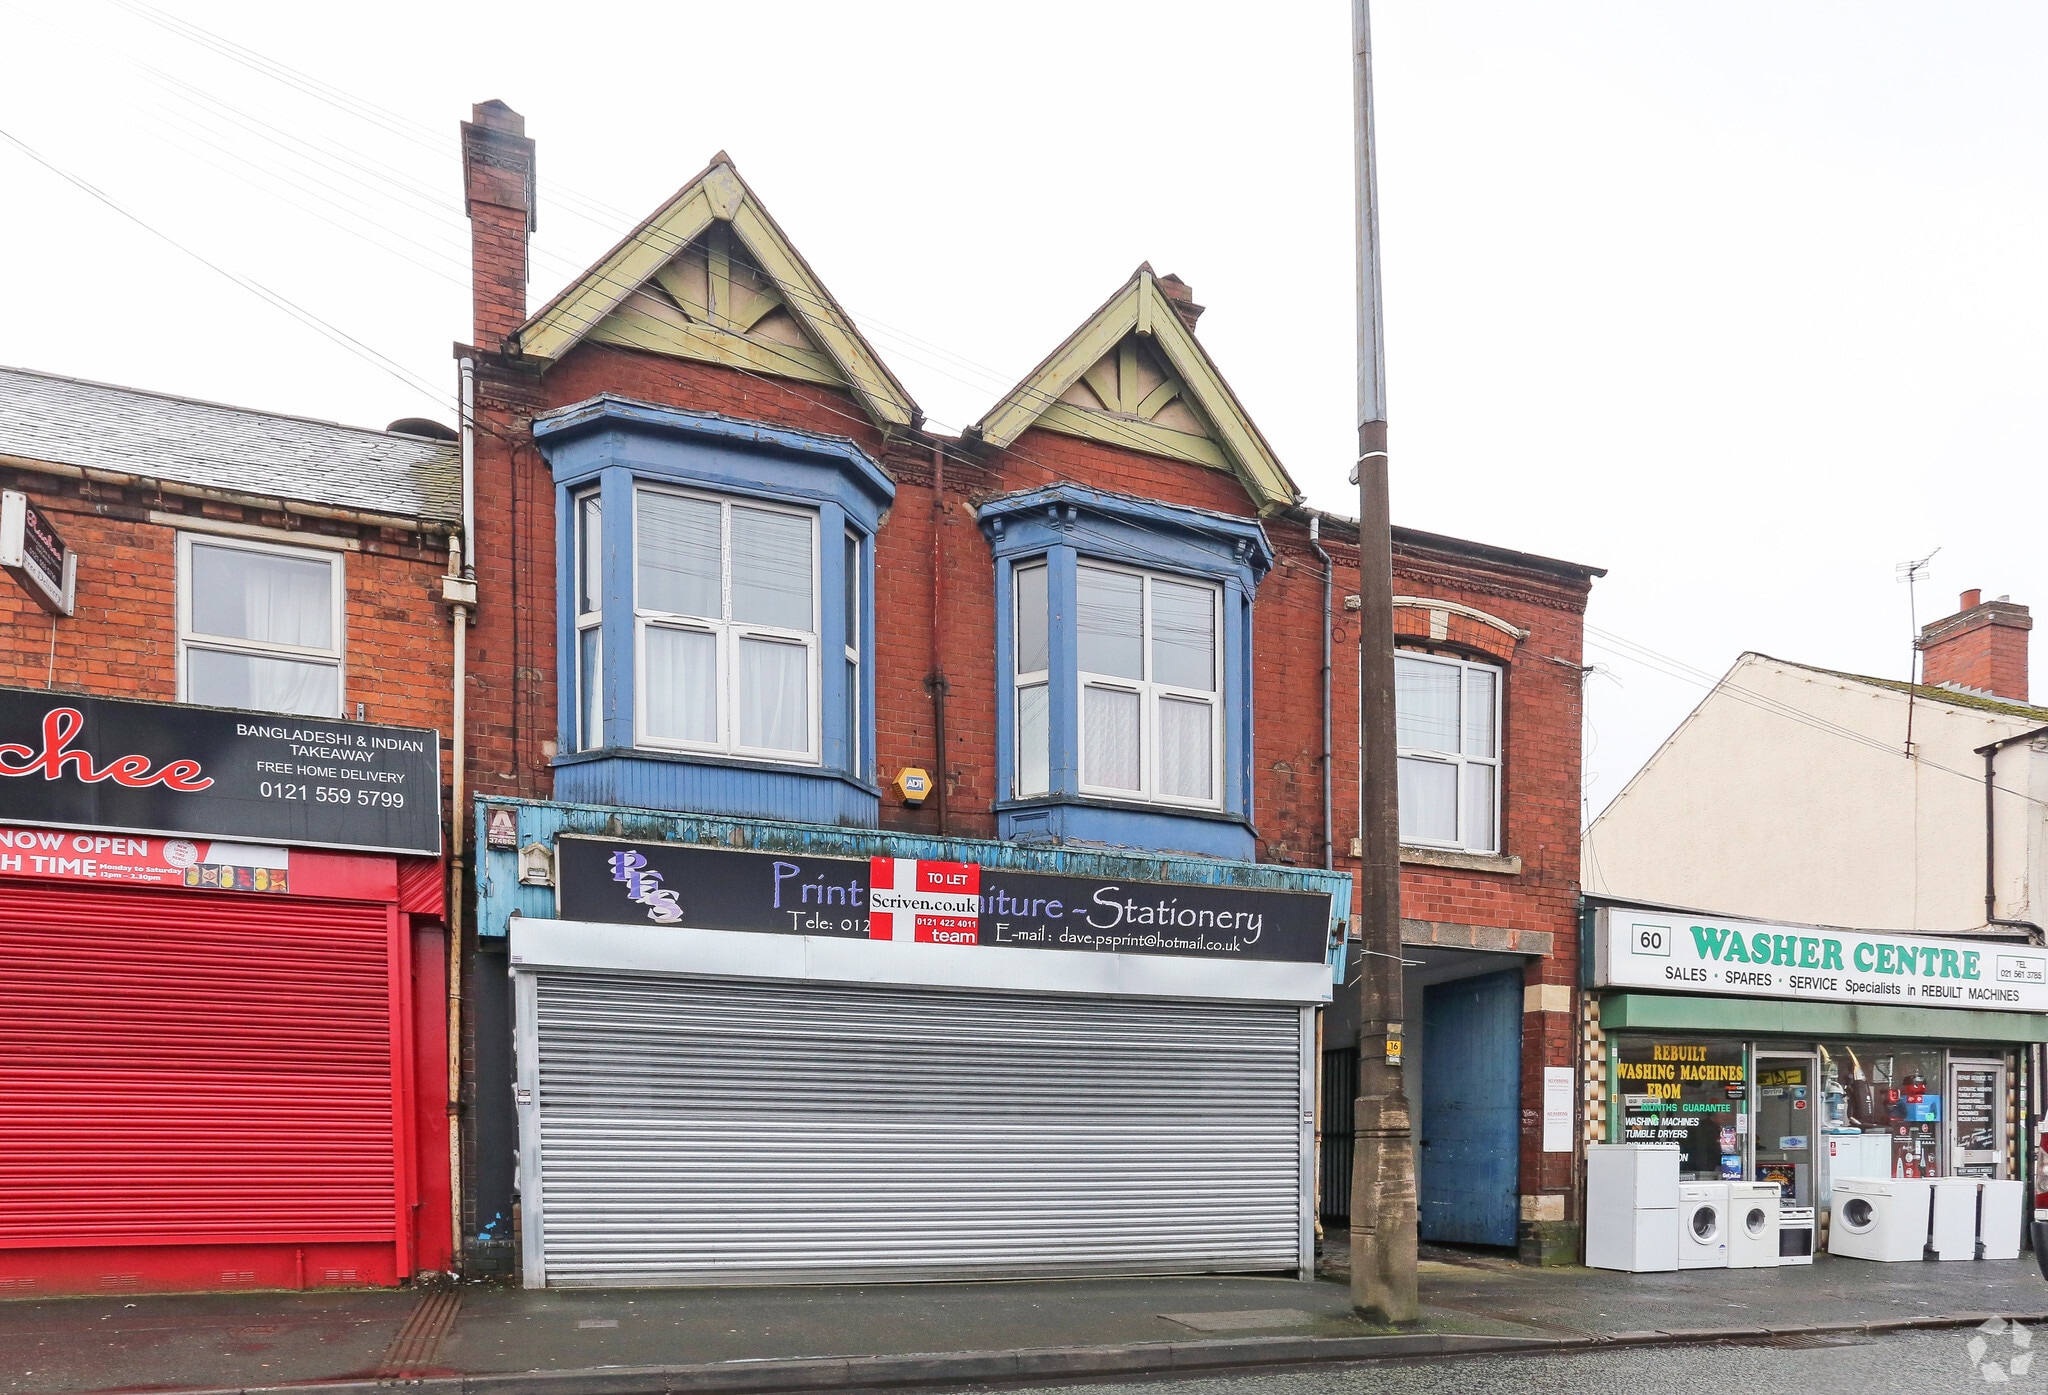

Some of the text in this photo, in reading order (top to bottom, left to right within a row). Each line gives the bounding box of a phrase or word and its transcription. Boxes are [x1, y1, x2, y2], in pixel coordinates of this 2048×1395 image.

[236, 724, 423, 752] BANGLADESHI & INDIAN
[289, 744, 375, 762] TAKEAWAY
[256, 761, 405, 783] FREE HOME DELIVERY
[906, 778, 924, 789] ADT
[260, 781, 404, 808] 0121 559 5799
[0, 831, 148, 857] NOW OPEN
[29, 855, 97, 877] TIME
[100, 863, 134, 873] Monday
[145, 867, 183, 876] Saturday
[100, 871, 122, 879] 12pm
[130, 873, 161, 881] 2.30pm
[927, 872, 968, 886] TO LET
[772, 861, 864, 909] Print
[1086, 886, 1263, 944] Stationery
[872, 893, 976, 913] Scriven.co.uk
[786, 910, 833, 931] Tele:
[917, 918, 976, 928] 0121 422 4011
[932, 929, 976, 944] team
[1059, 926, 1241, 952] dave.psprint@hotmail.co.uk
[1640, 926, 1981, 981] 60 WASHER CENTRE
[2016, 960, 2027, 968] TEL
[2001, 969, 2042, 980] 021 561 3785
[1665, 966, 2020, 1002] SALES SPARES SERVICE Specialists in REBUILT MACHINES
[1390, 1042, 1399, 1050] 16
[1653, 1045, 1707, 1061] REBUILT
[1617, 1063, 1675, 1080] WASHING
[1680, 1064, 1744, 1081] MACHINES
[1647, 1083, 1681, 1099] FROM
[1641, 1103, 1731, 1112] MONTHS GUARANTEE
[1625, 1116, 1700, 1127] WASHING MACHINES
[1625, 1129, 1688, 1138] TUMBLE DRYERS
